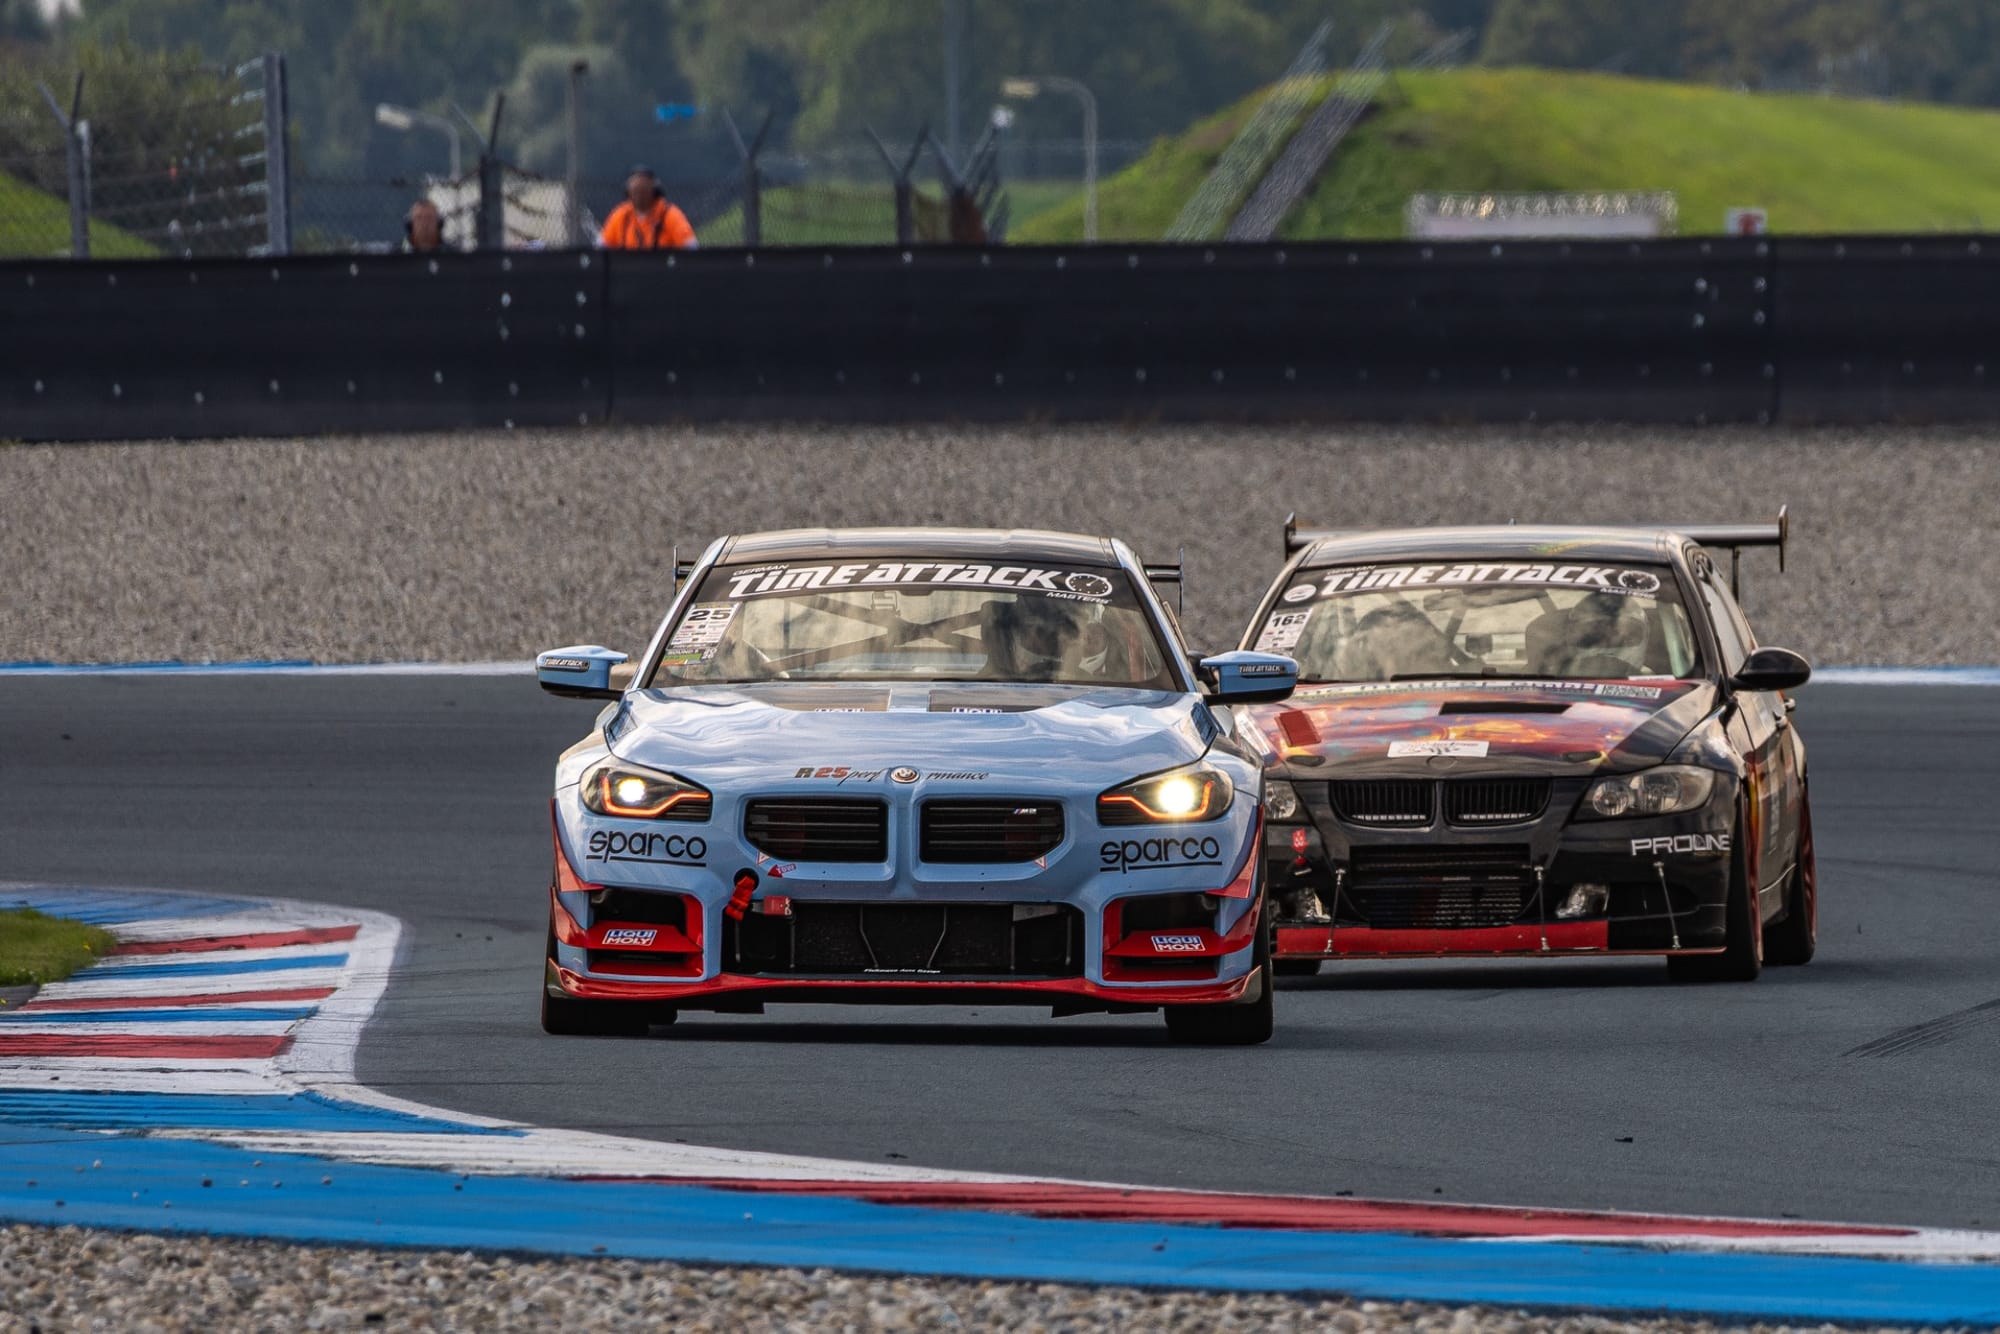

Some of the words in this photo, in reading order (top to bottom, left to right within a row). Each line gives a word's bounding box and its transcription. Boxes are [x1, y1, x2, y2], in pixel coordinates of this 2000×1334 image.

[687, 609, 734, 621] 25
[1272, 613, 1306, 627] 162
[588, 830, 707, 864] sparco
[1631, 833, 1731, 856] PROLINE
[1100, 836, 1220, 874] sparco
[609, 930, 654, 938] LIQUI
[1154, 936, 1200, 944] LIQUI
[606, 937, 652, 946] MOLY
[1157, 943, 1202, 951] MOLY
